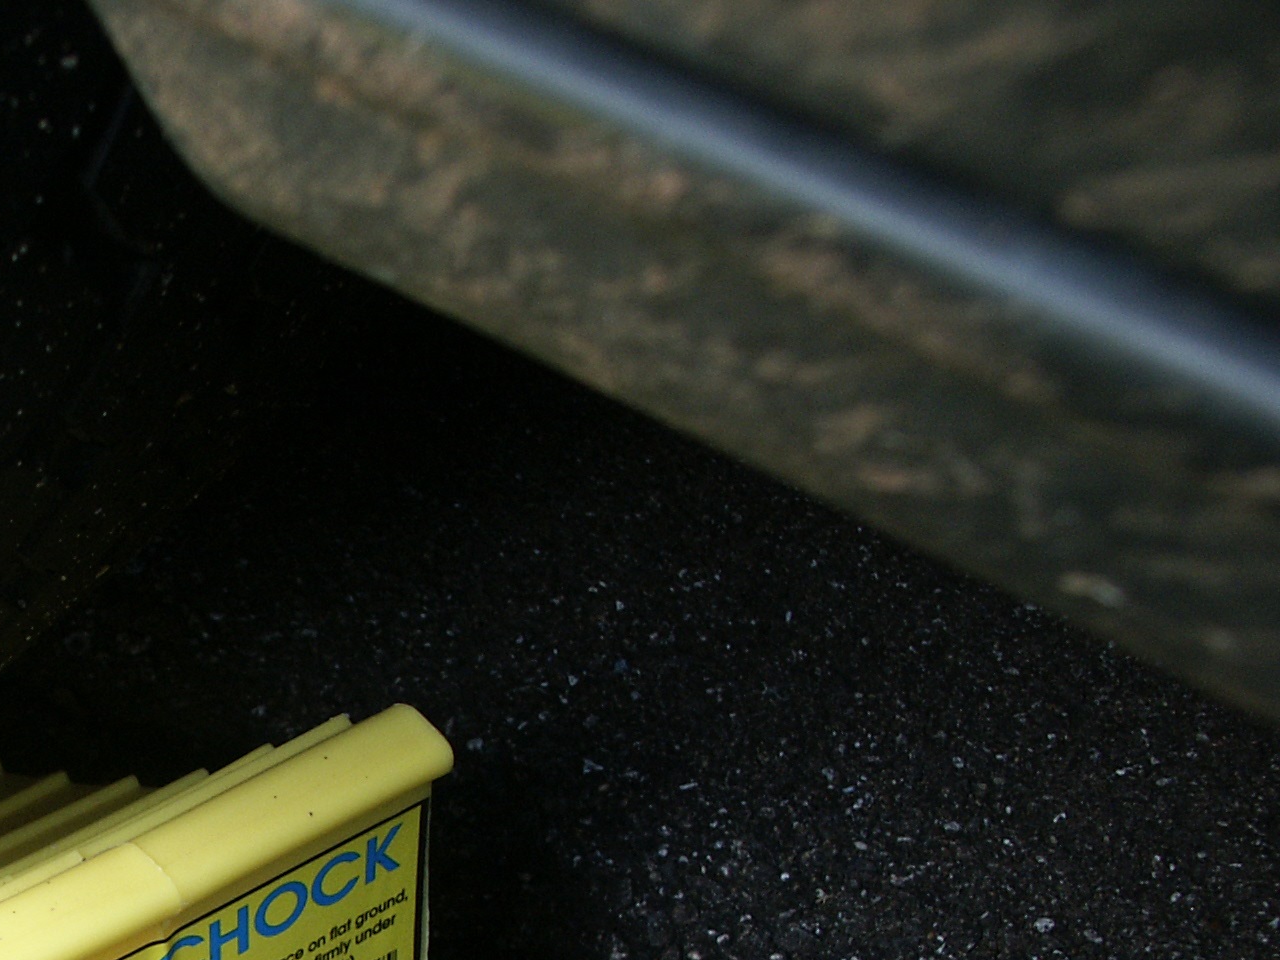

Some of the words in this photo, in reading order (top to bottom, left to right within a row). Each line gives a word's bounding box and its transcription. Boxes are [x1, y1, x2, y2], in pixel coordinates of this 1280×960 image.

[308, 935, 327, 953] on
[329, 918, 352, 942] flat
[355, 888, 409, 930] ground,
[355, 914, 397, 945] under
